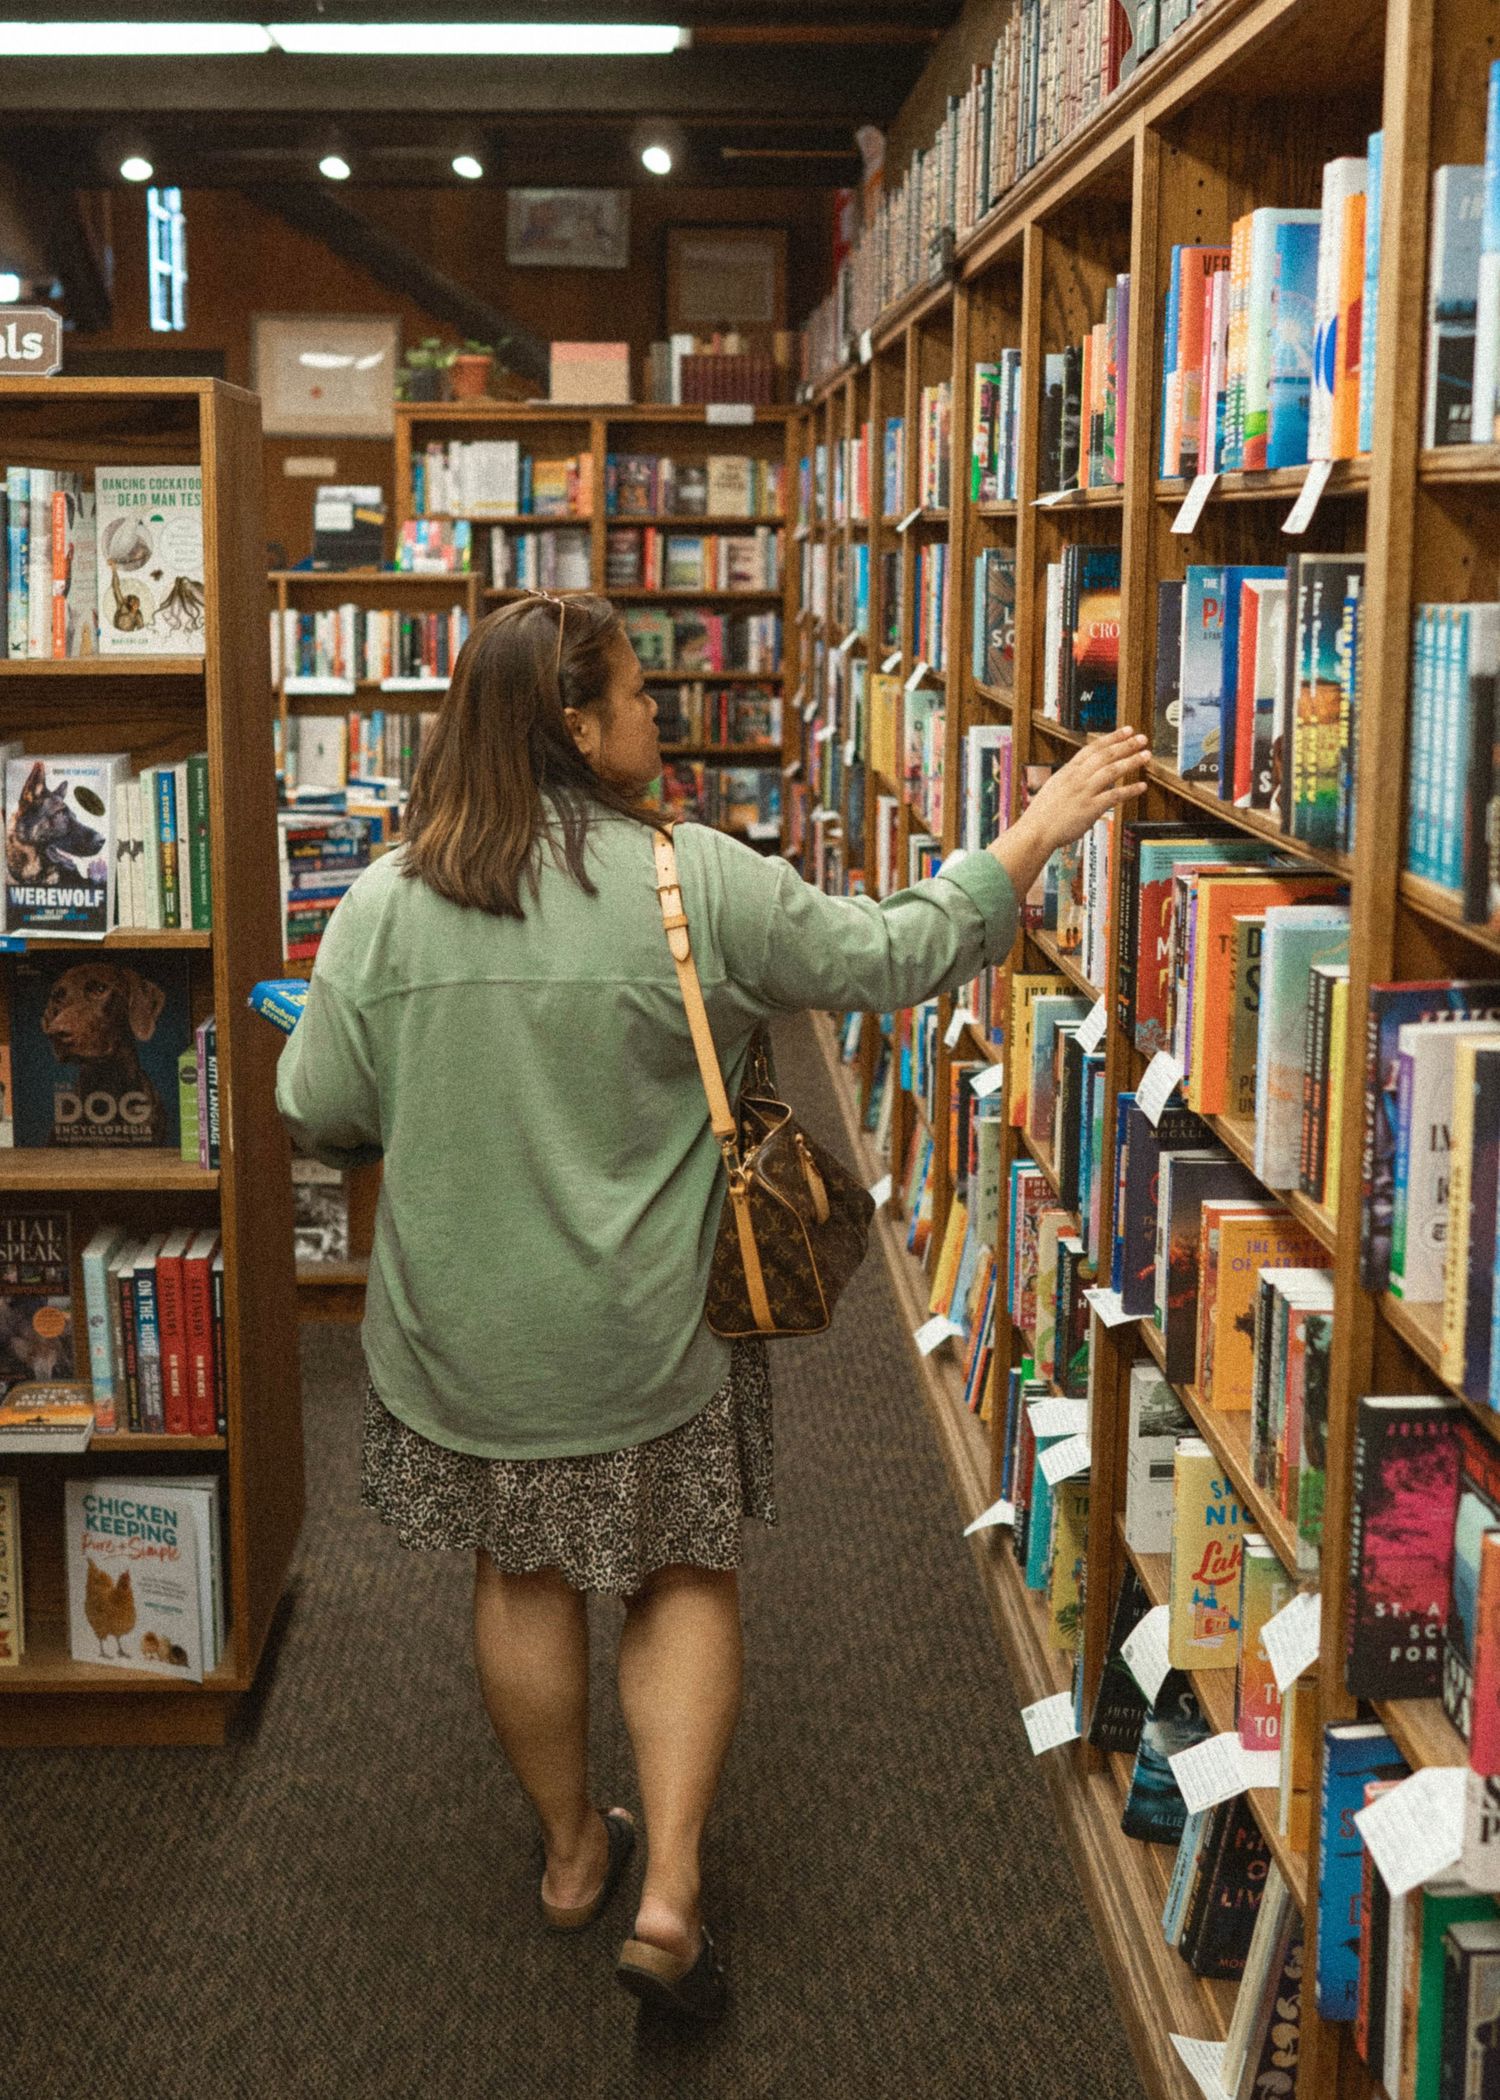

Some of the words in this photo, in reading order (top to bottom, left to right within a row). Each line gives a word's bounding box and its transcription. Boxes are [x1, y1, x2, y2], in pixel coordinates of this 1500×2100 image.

[102, 478, 146, 490] DANCING
[117, 493, 148, 506] DEAD
[151, 493, 176, 506] MAN
[10, 886, 105, 907] WEREWOLF
[207, 1056, 218, 1086] KITTY
[53, 1091, 153, 1124] DOG
[209, 1088, 220, 1145] LANGUAGE
[54, 1124, 154, 1135] ENCYCLOPEDIA
[138, 1279, 152, 1296] ON
[139, 1299, 155, 1321] THE
[140, 1323, 160, 1358] HOOF
[82, 1494, 178, 1528] CHICKEN
[84, 1513, 178, 1547] KEEPING
[128, 1536, 181, 1562] Simple
[1390, 1646, 1438, 1663] FOR
